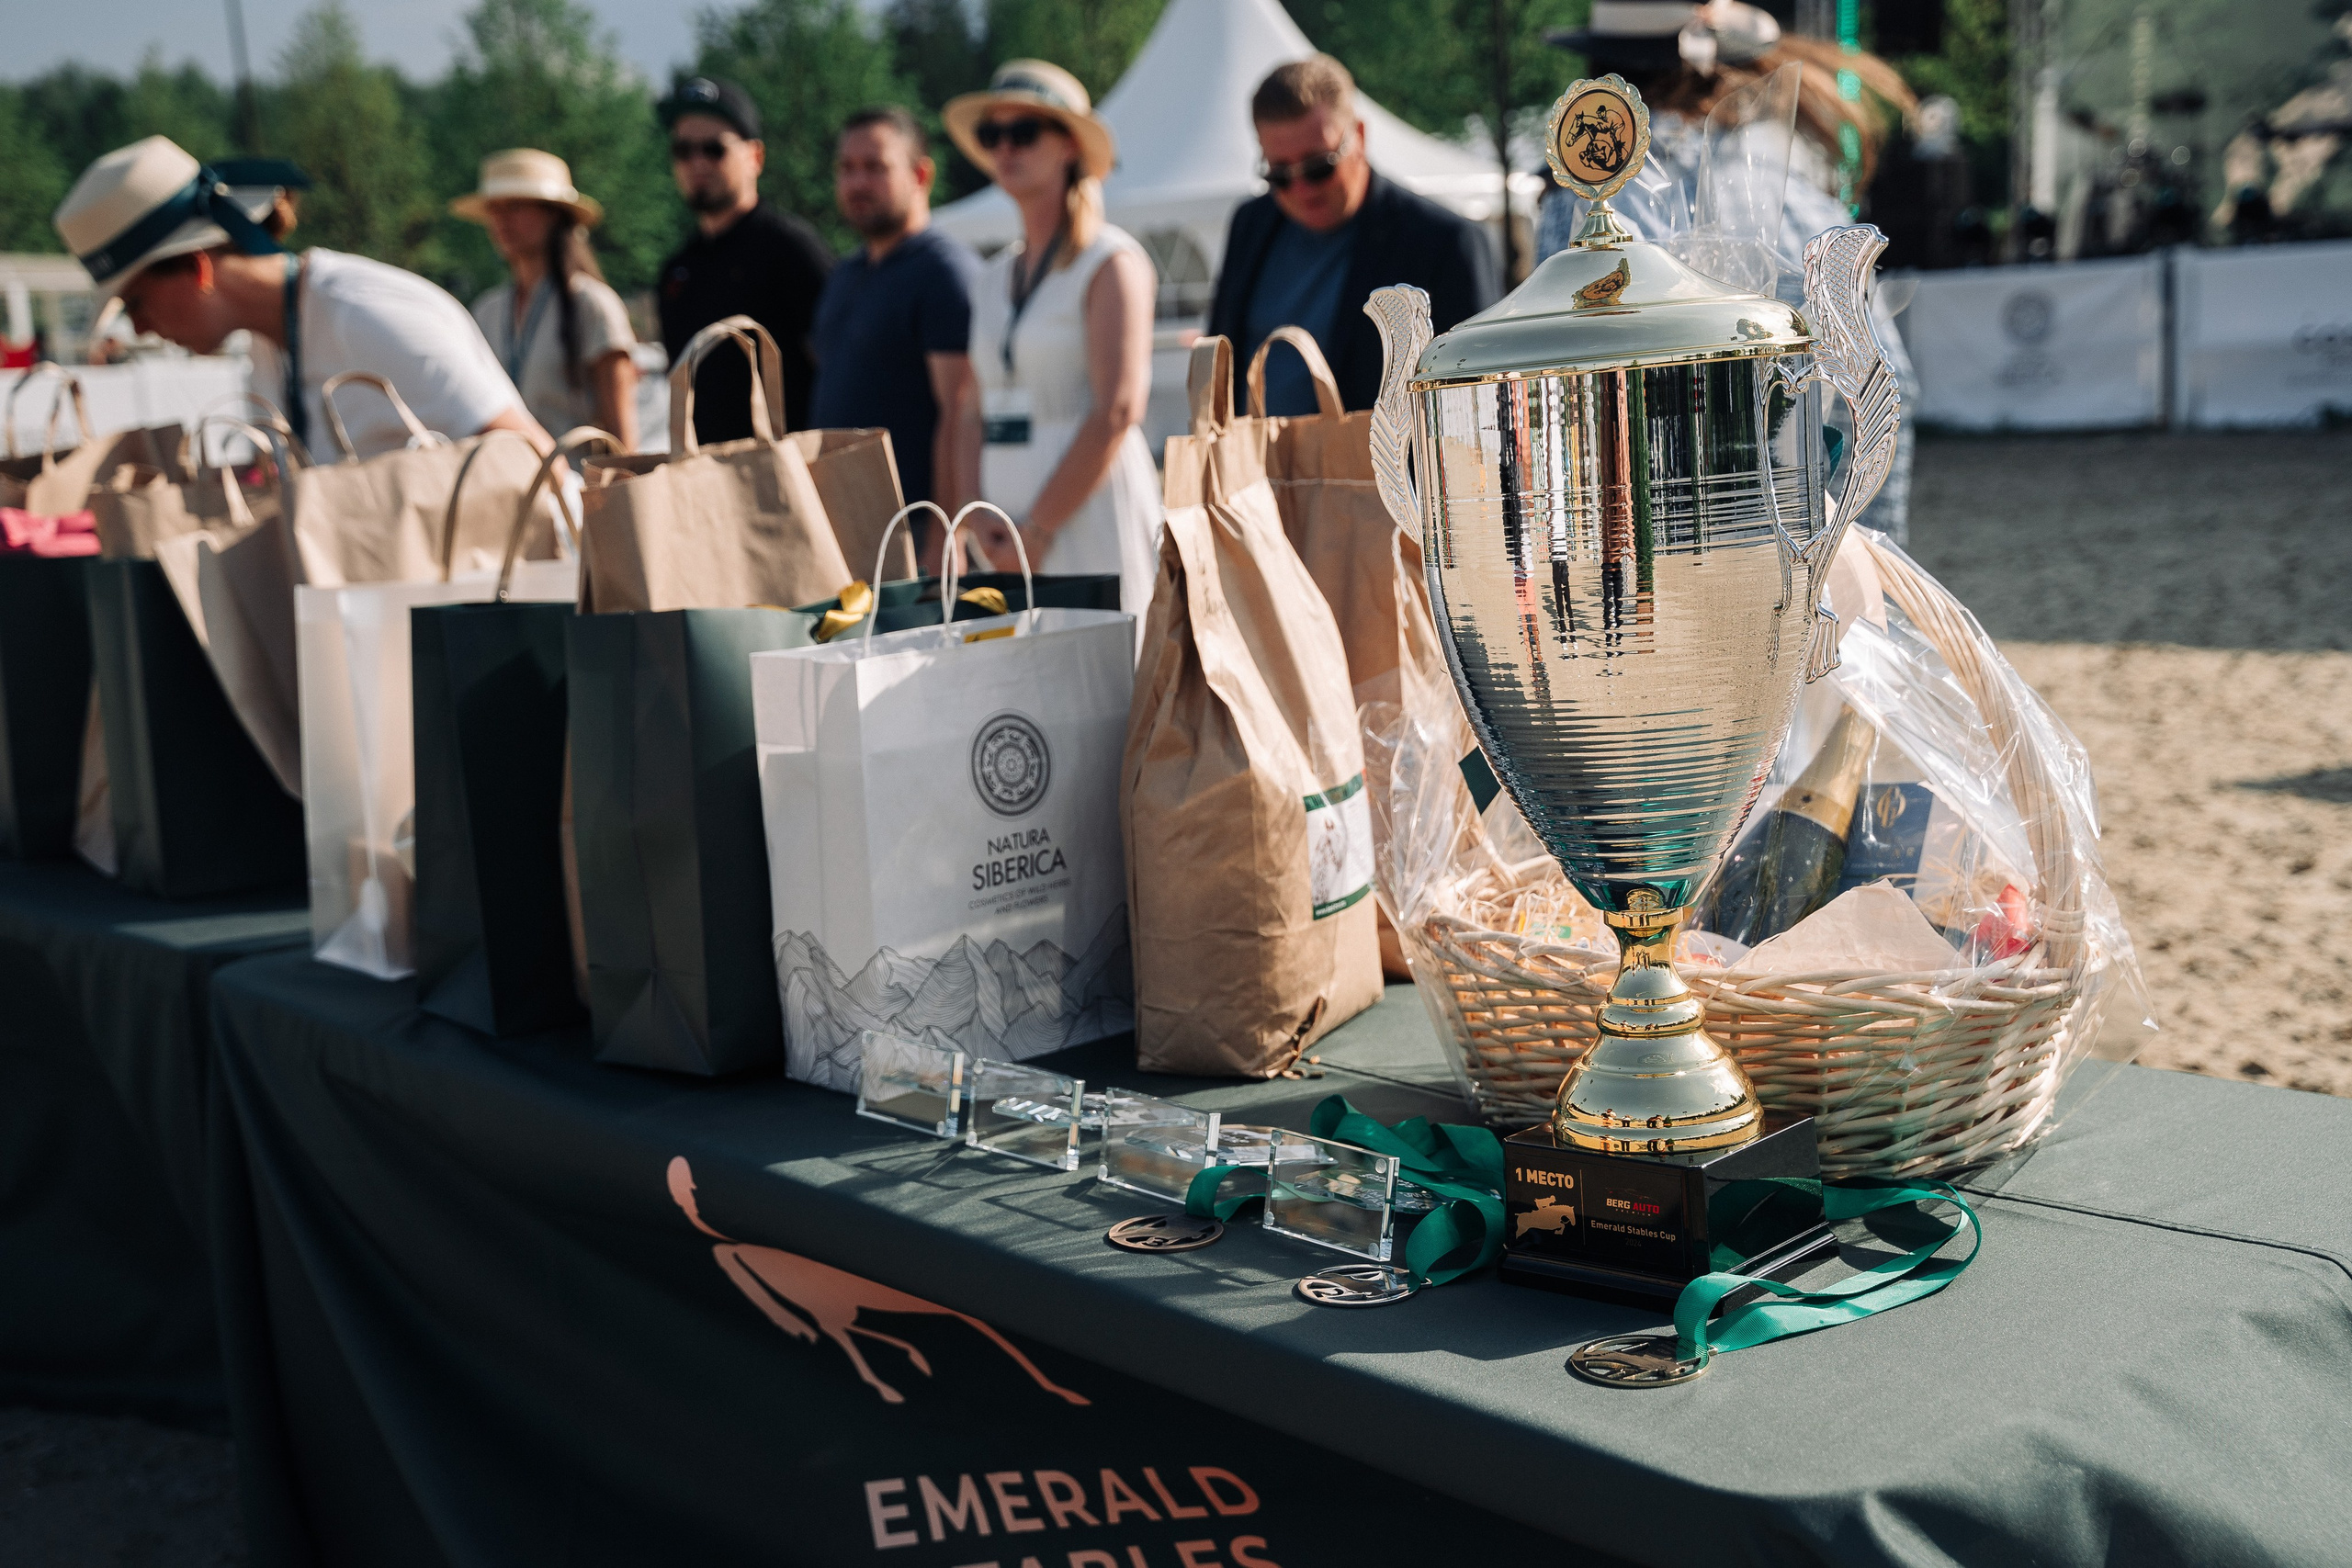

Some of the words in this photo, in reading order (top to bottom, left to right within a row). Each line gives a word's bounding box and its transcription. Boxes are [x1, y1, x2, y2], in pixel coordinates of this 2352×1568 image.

[987, 828, 1051, 855] NATURA
[972, 847, 1068, 891] SIBERICA
[1515, 1167, 1522, 1182] 1
[1526, 1168, 1575, 1190] МЕСТО
[1606, 1198, 1631, 1210] BERG
[1633, 1202, 1659, 1214] AUTO
[1590, 1219, 1625, 1233] Emerald
[1626, 1225, 1658, 1238] Stables
[1659, 1231, 1676, 1243] Cup
[864, 1466, 1260, 1551] EMERALD
